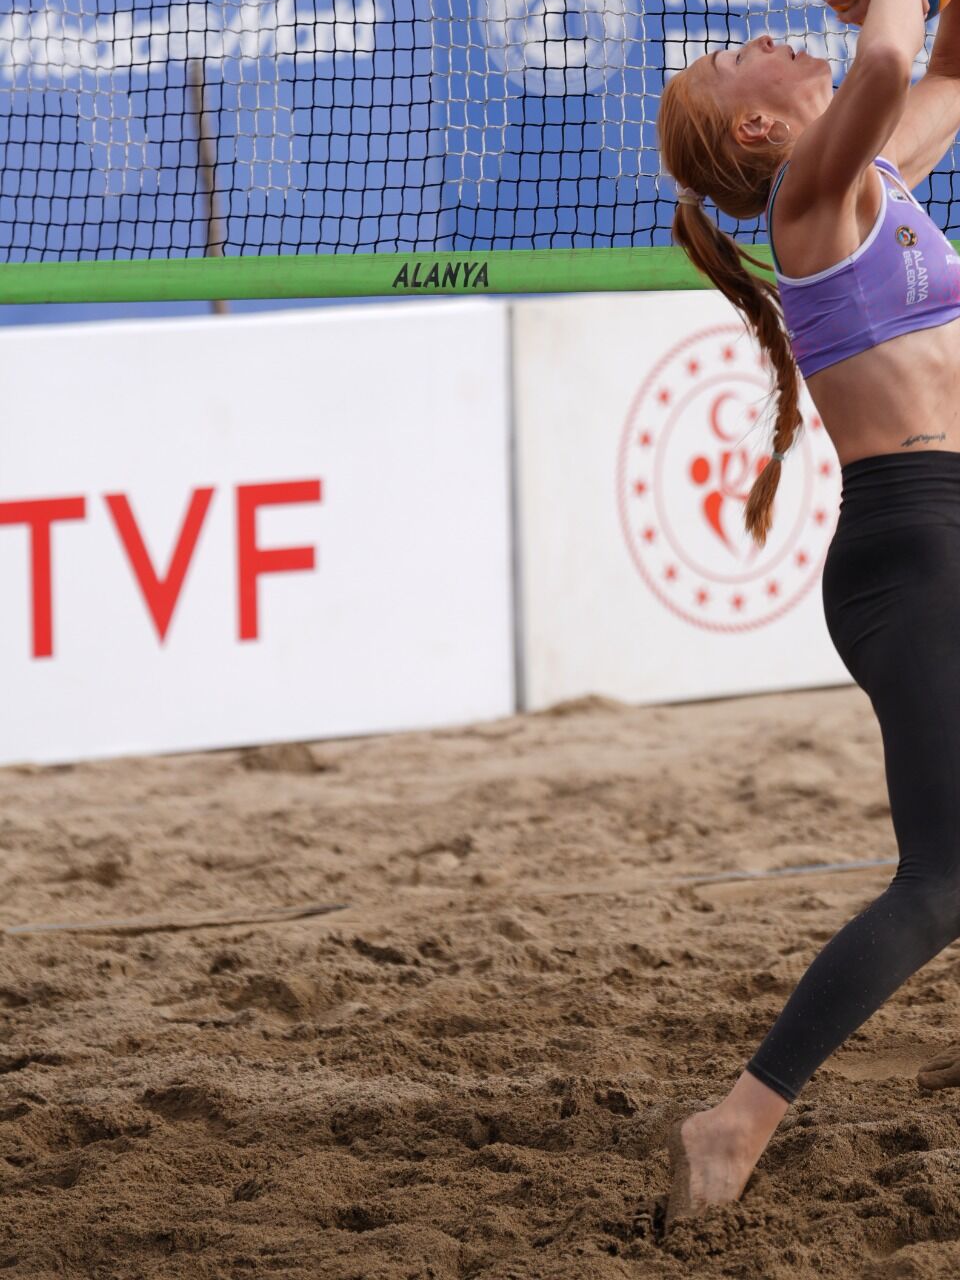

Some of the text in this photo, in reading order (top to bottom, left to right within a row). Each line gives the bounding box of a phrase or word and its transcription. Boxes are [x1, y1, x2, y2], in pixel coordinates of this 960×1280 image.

[392, 262, 489, 288] ALANYA
[911, 249, 929, 303] ALANYA
[0, 477, 323, 660] TVF
